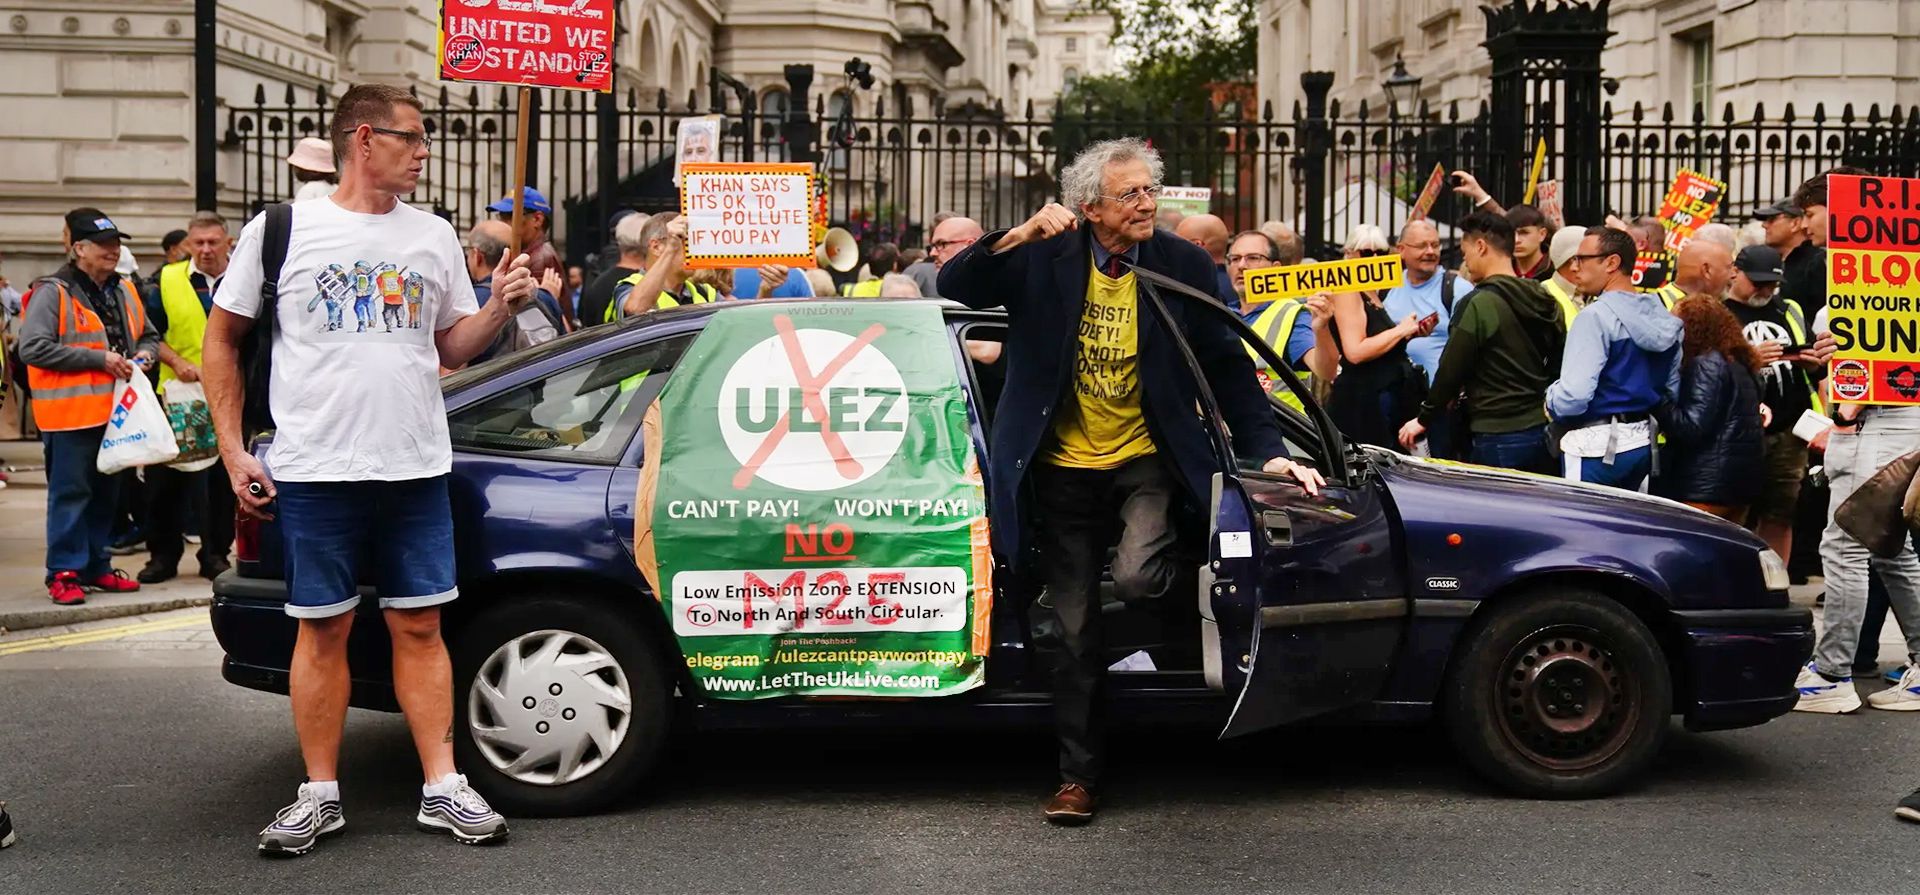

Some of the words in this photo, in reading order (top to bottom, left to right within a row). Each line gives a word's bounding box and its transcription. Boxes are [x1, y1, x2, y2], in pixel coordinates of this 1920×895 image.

[449, 16, 551, 45] UNITED
[565, 26, 607, 50] WE
[448, 50, 482, 60] KHAN
[451, 42, 478, 51] FCUK
[485, 47, 573, 74] STAND
[579, 51, 605, 61] STOP
[573, 59, 609, 73] ULEZ
[700, 178, 744, 193] KHAN
[750, 178, 791, 193] SAYS
[1686, 185, 1706, 200] NO
[691, 194, 717, 210] ITS
[723, 194, 747, 209] OK
[755, 194, 776, 209] TO
[1669, 191, 1714, 220] ULEZ
[722, 210, 803, 226] POLLUTE
[1672, 210, 1693, 227] NO
[692, 230, 706, 245] IF
[710, 230, 744, 245] YOU
[749, 229, 781, 245] PAY
[1251, 272, 1291, 295] GET
[1296, 266, 1351, 290] KHAN
[1356, 261, 1396, 284] OUT
[1832, 252, 1920, 288] BLO
[787, 306, 854, 316] WINDOW
[1829, 294, 1855, 310] ON
[1860, 295, 1911, 312] YOUR
[1079, 320, 1120, 343] DEFY!
[1829, 317, 1920, 354] SUN
[735, 387, 904, 433] ULEZ
[668, 499, 740, 519] CAN'T
[747, 499, 799, 518] PAY!
[835, 499, 915, 517] WON'T
[920, 499, 969, 517] PAY!
[785, 522, 855, 556] NO
[684, 586, 720, 599] Low
[726, 583, 803, 598] Emission
[809, 583, 852, 596] Zone
[858, 581, 955, 596] EXTENSION
[1429, 580, 1458, 588] CLASSIC
[743, 570, 906, 630] M25
[691, 610, 712, 623] To
[718, 608, 770, 622] North
[775, 606, 809, 620] And
[815, 606, 866, 620] South
[871, 605, 944, 619] Circular.
[780, 638, 796, 647] Join
[683, 652, 760, 671] elegram
[774, 649, 967, 667] /ulezcantpaywontpay
[702, 671, 940, 692] Www.LetTheUkLive.com
